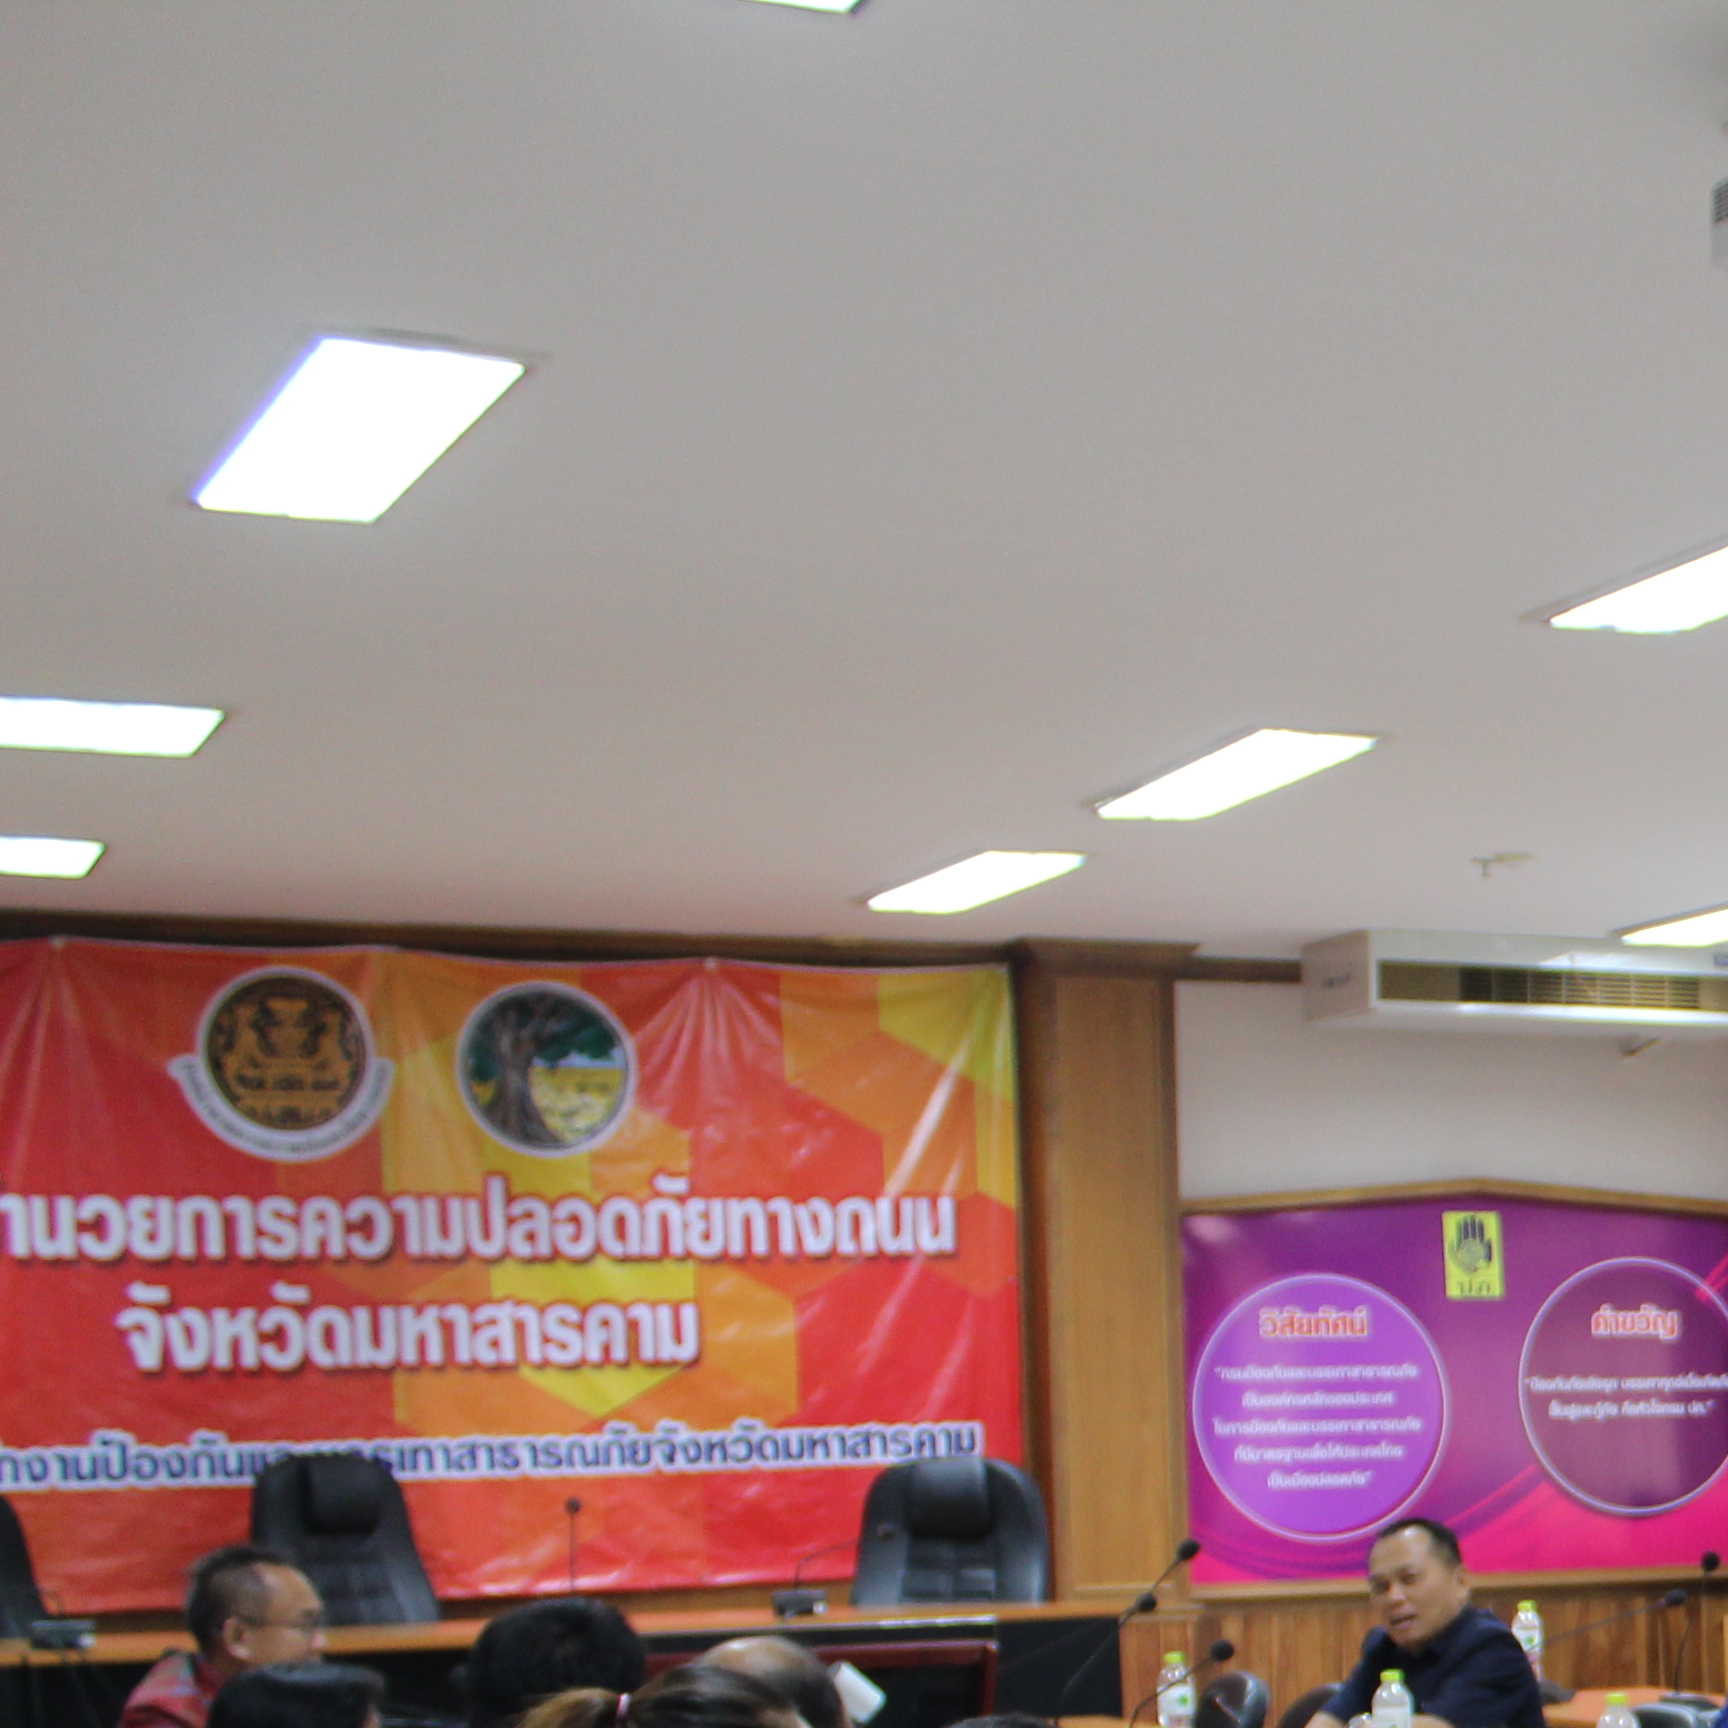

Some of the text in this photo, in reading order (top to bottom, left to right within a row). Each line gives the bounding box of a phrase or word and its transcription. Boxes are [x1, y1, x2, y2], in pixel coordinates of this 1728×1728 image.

[115, 1280, 699, 1371] จังหวัดมหาสารคาม
